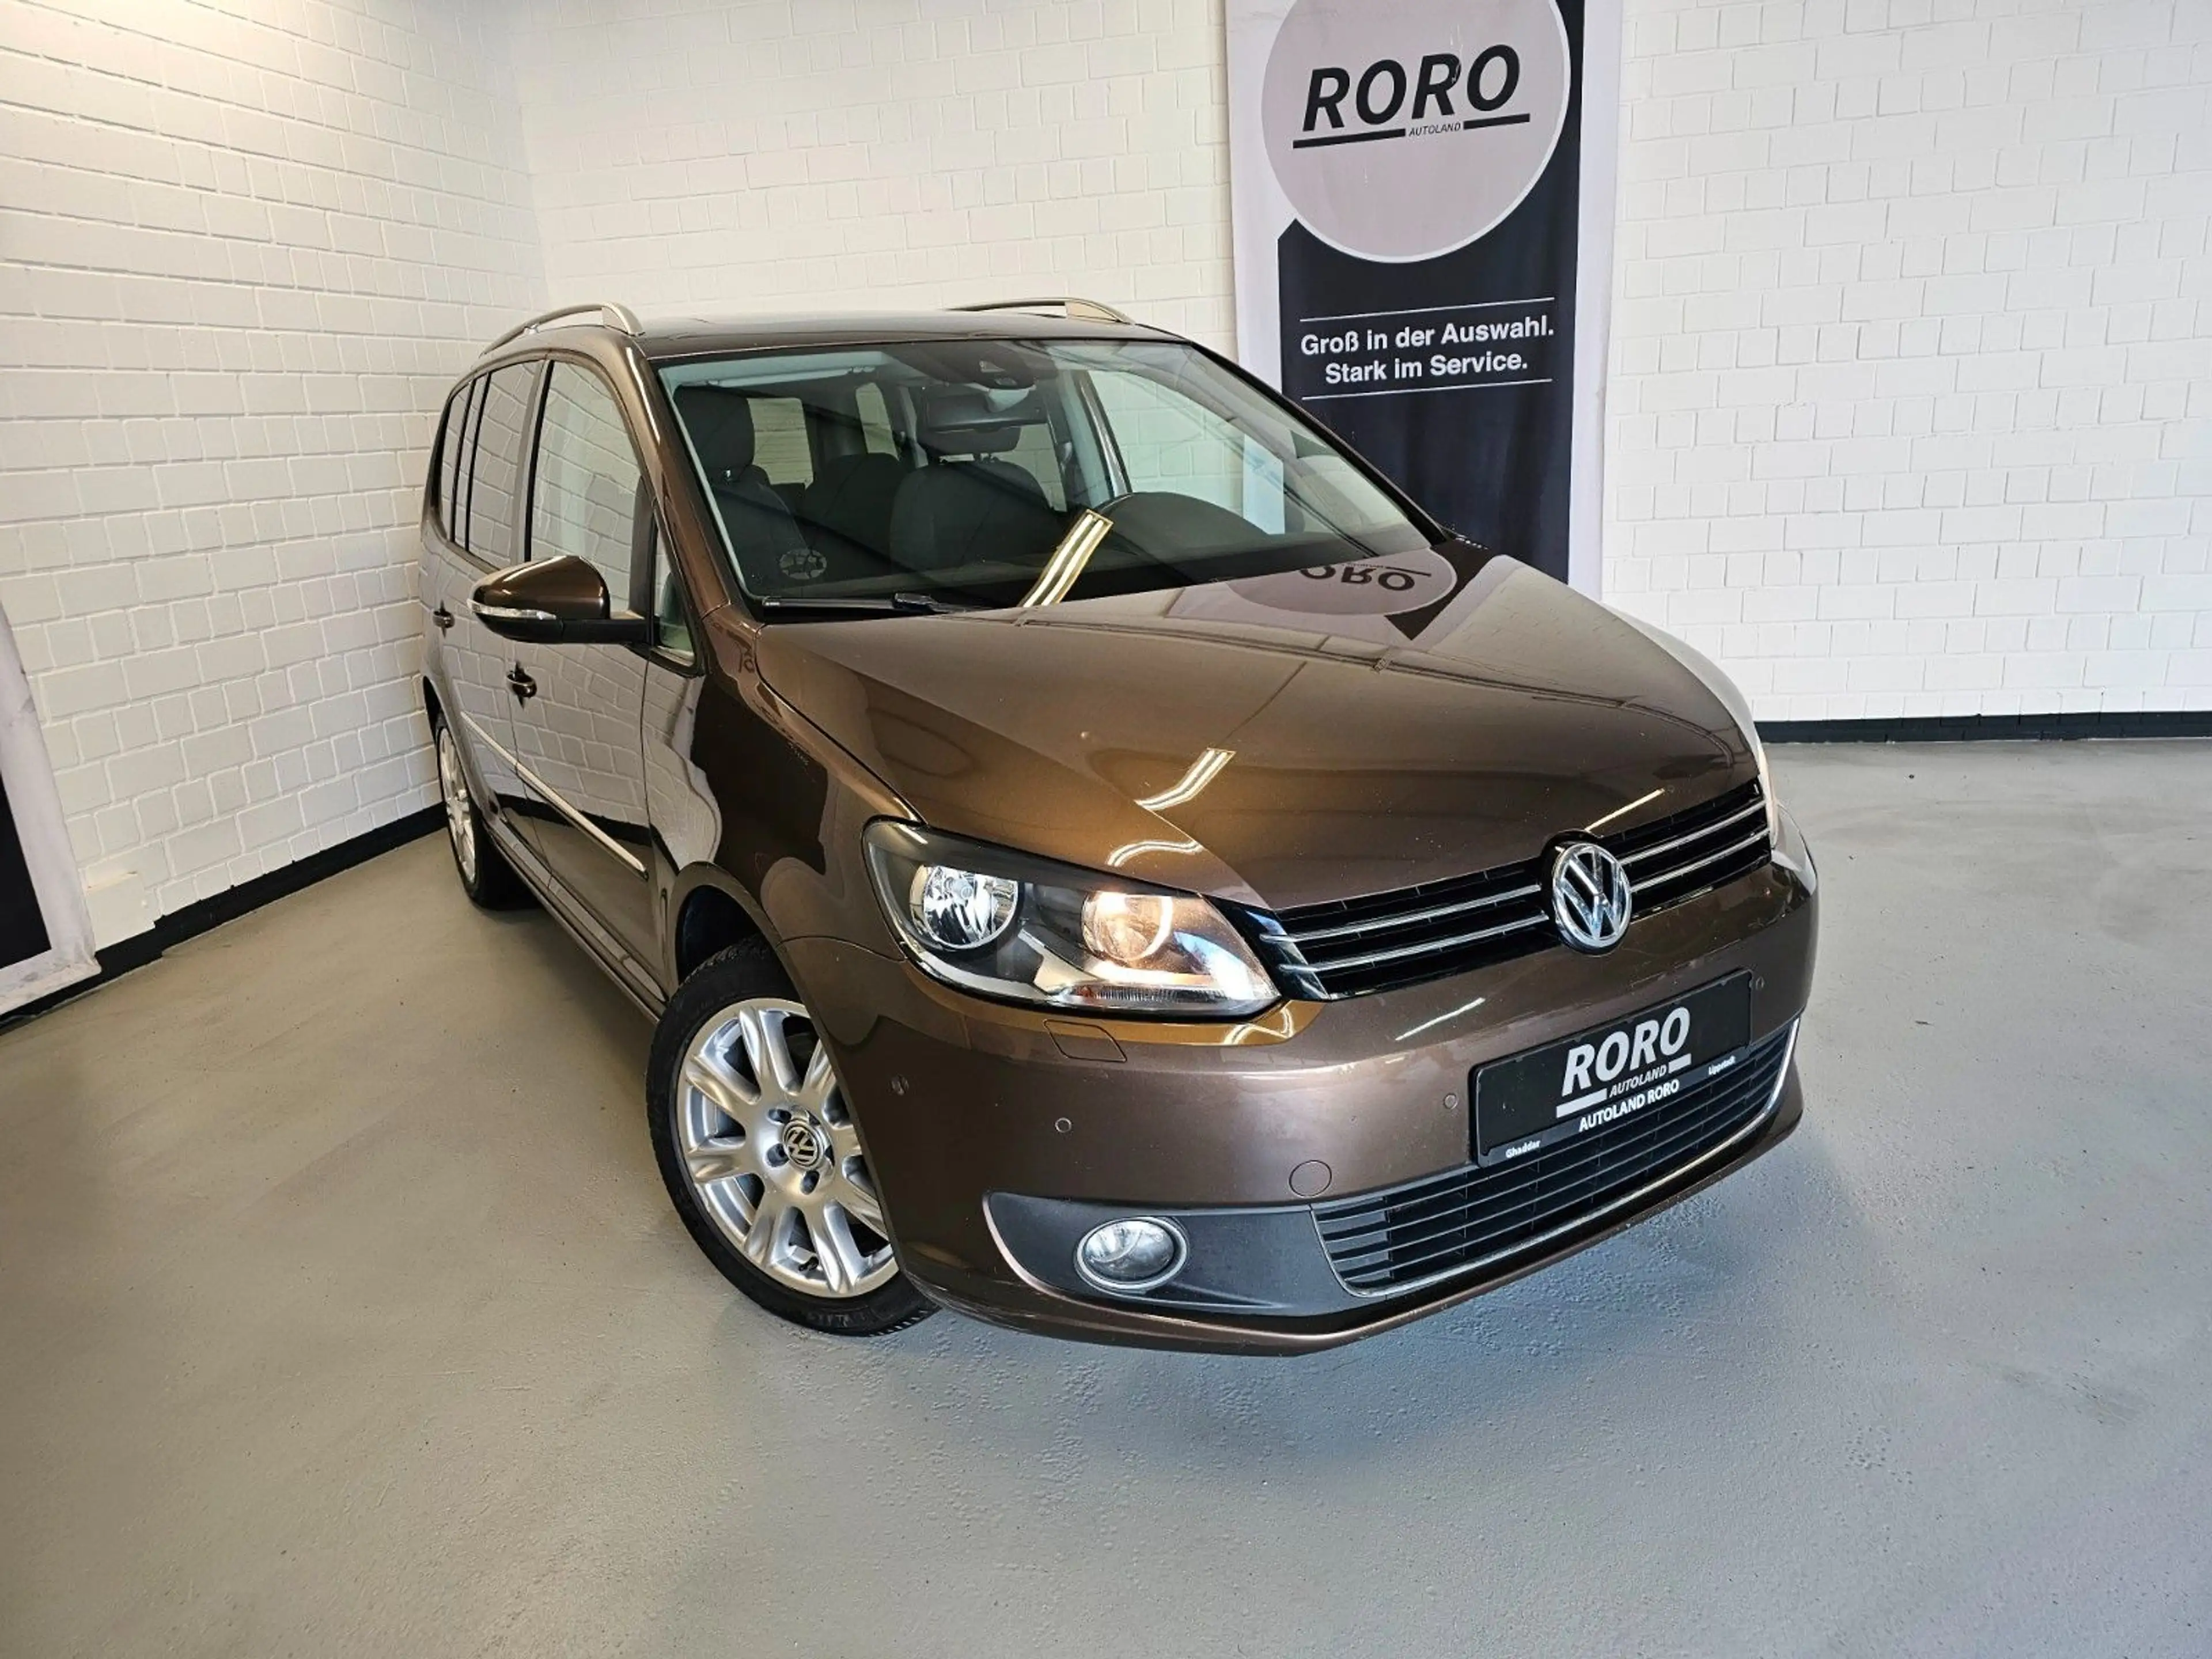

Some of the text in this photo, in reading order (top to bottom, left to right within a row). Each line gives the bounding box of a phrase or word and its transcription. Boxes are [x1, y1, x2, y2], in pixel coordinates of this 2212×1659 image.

[1302, 44, 1520, 131] RORO
[1408, 122, 1461, 137] AUTOLAND
[1300, 315, 1554, 355] Groß in der Auswahl.
[1325, 351, 1528, 384] Stark im Service.
[1562, 1007, 1690, 1097] RORO
[1609, 1065, 1667, 1098] AUTOLAND
[1578, 1079, 1680, 1132] AUTOLAND RORO
